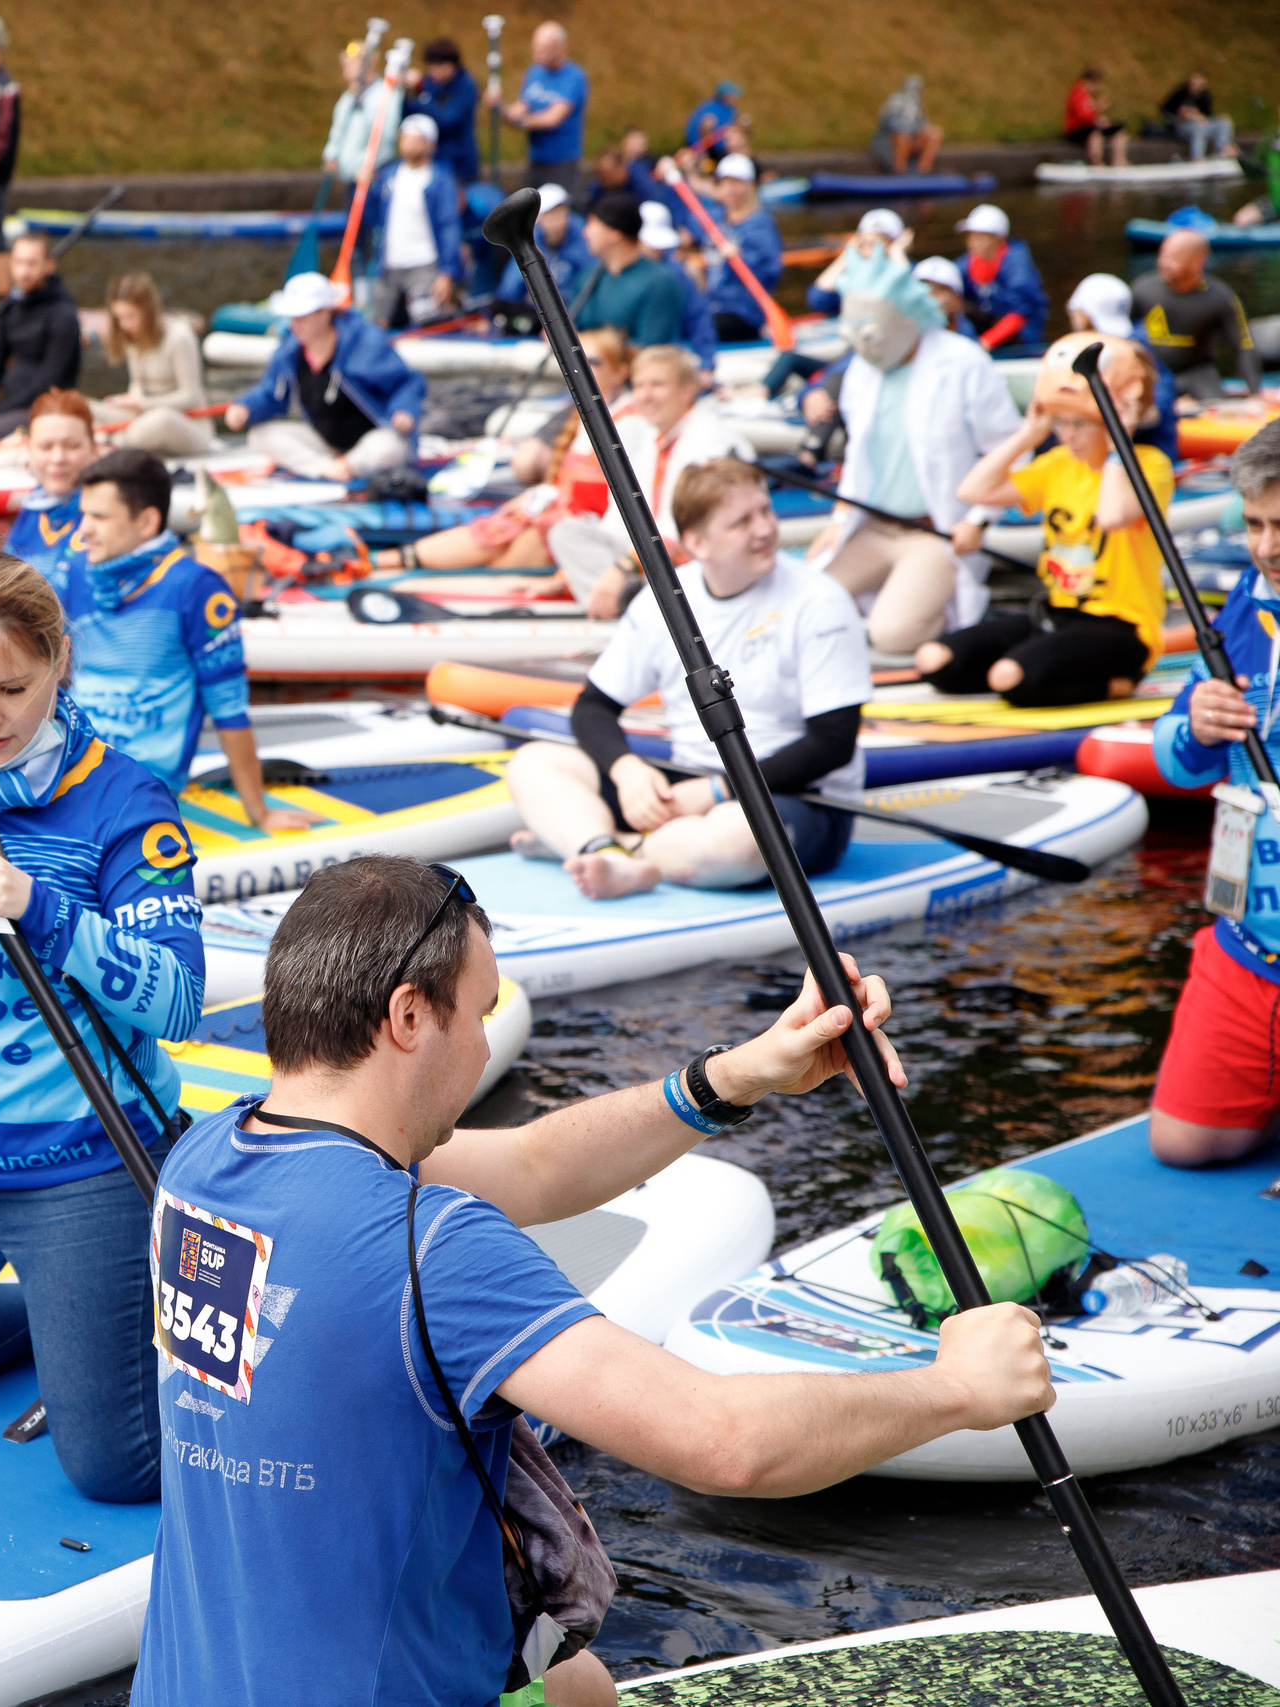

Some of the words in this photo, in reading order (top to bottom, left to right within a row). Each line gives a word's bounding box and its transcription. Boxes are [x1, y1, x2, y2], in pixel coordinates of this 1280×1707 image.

[96, 926, 142, 1002] UP
[132, 938, 163, 1014] ТАНКА
[200, 1247, 225, 1271] SUP
[160, 1280, 239, 1363] 3543
[258, 1458, 316, 1491] ВТБ
